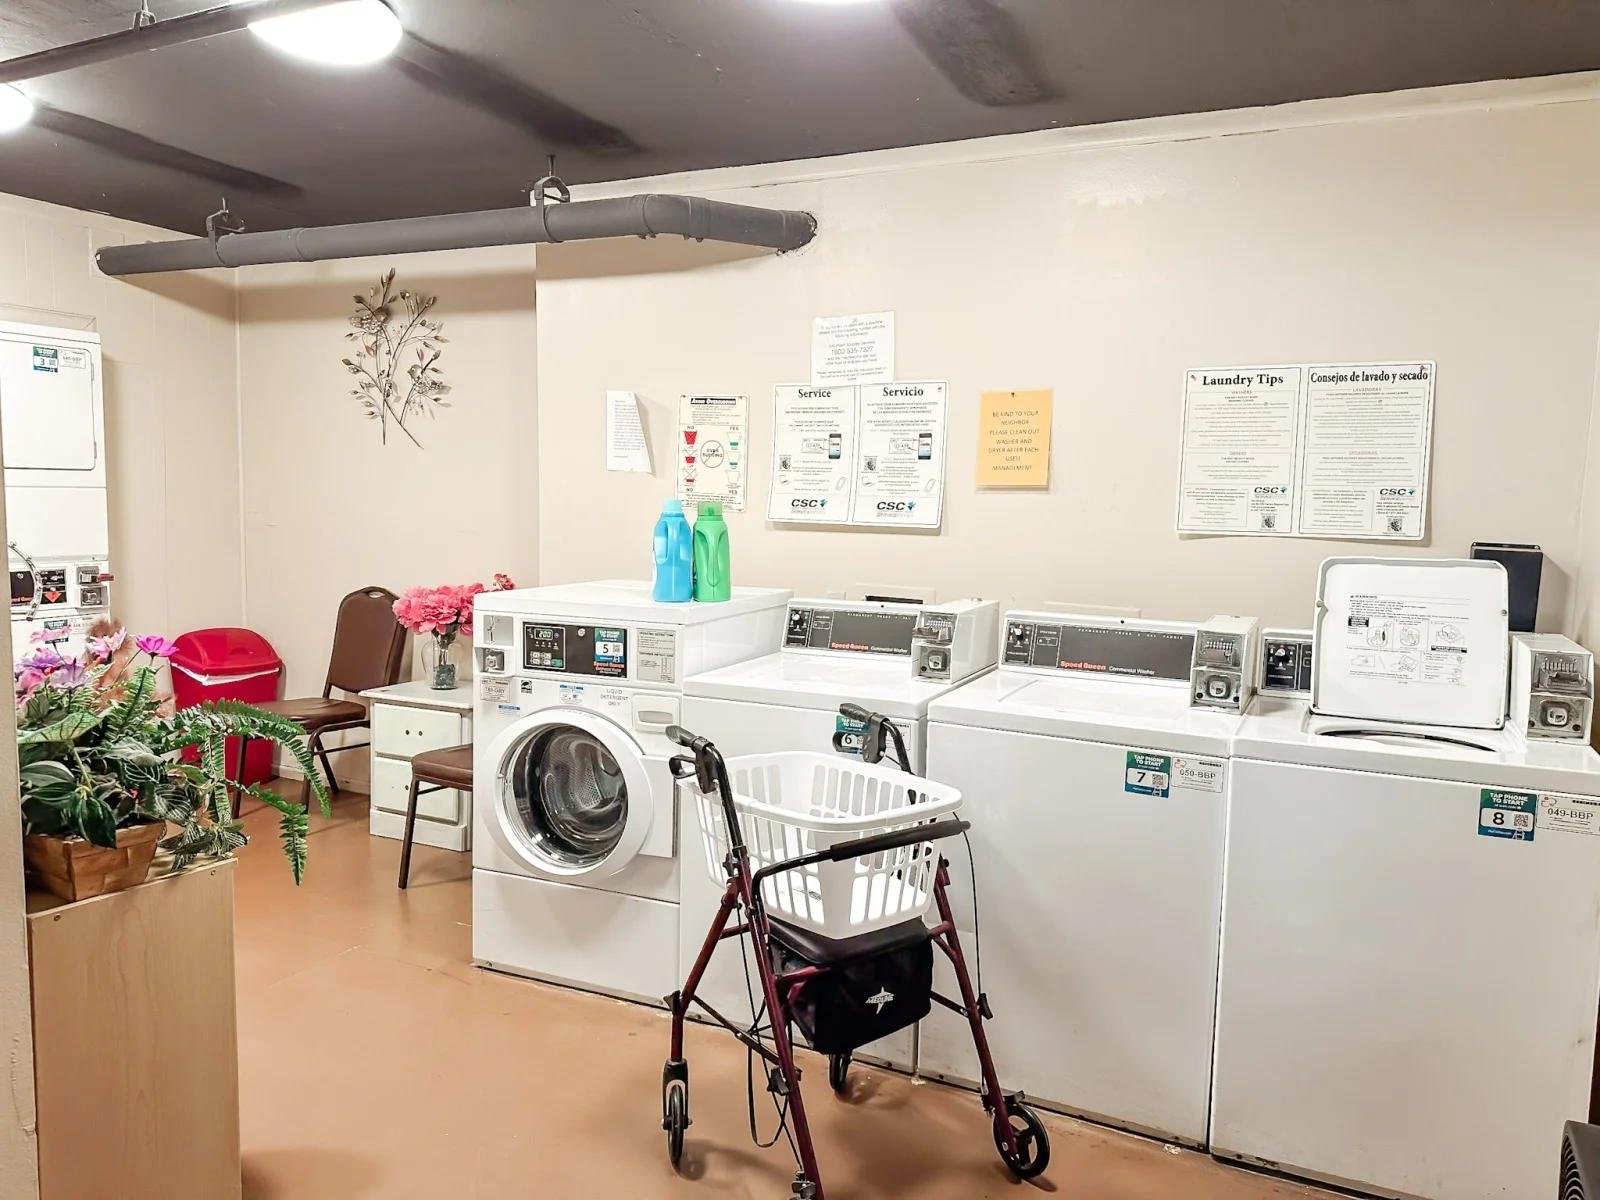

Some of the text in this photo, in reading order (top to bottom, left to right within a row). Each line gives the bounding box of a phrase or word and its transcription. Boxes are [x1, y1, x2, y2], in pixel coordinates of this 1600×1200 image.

[1202, 374, 1284, 387] Laundry Tips
[1311, 369, 1428, 385] Consejos de lavado y secado
[798, 389, 832, 398] Service
[883, 386, 924, 397] Servicio
[791, 499, 818, 508] CSC
[877, 502, 906, 510] CSC
[603, 644, 608, 653] 5
[845, 734, 852, 744] 6
[1137, 772, 1146, 783] 7
[1180, 769, 1216, 779] 050-BBP
[1492, 812, 1504, 825] 8
[1548, 808, 1593, 820] 049-BBP
